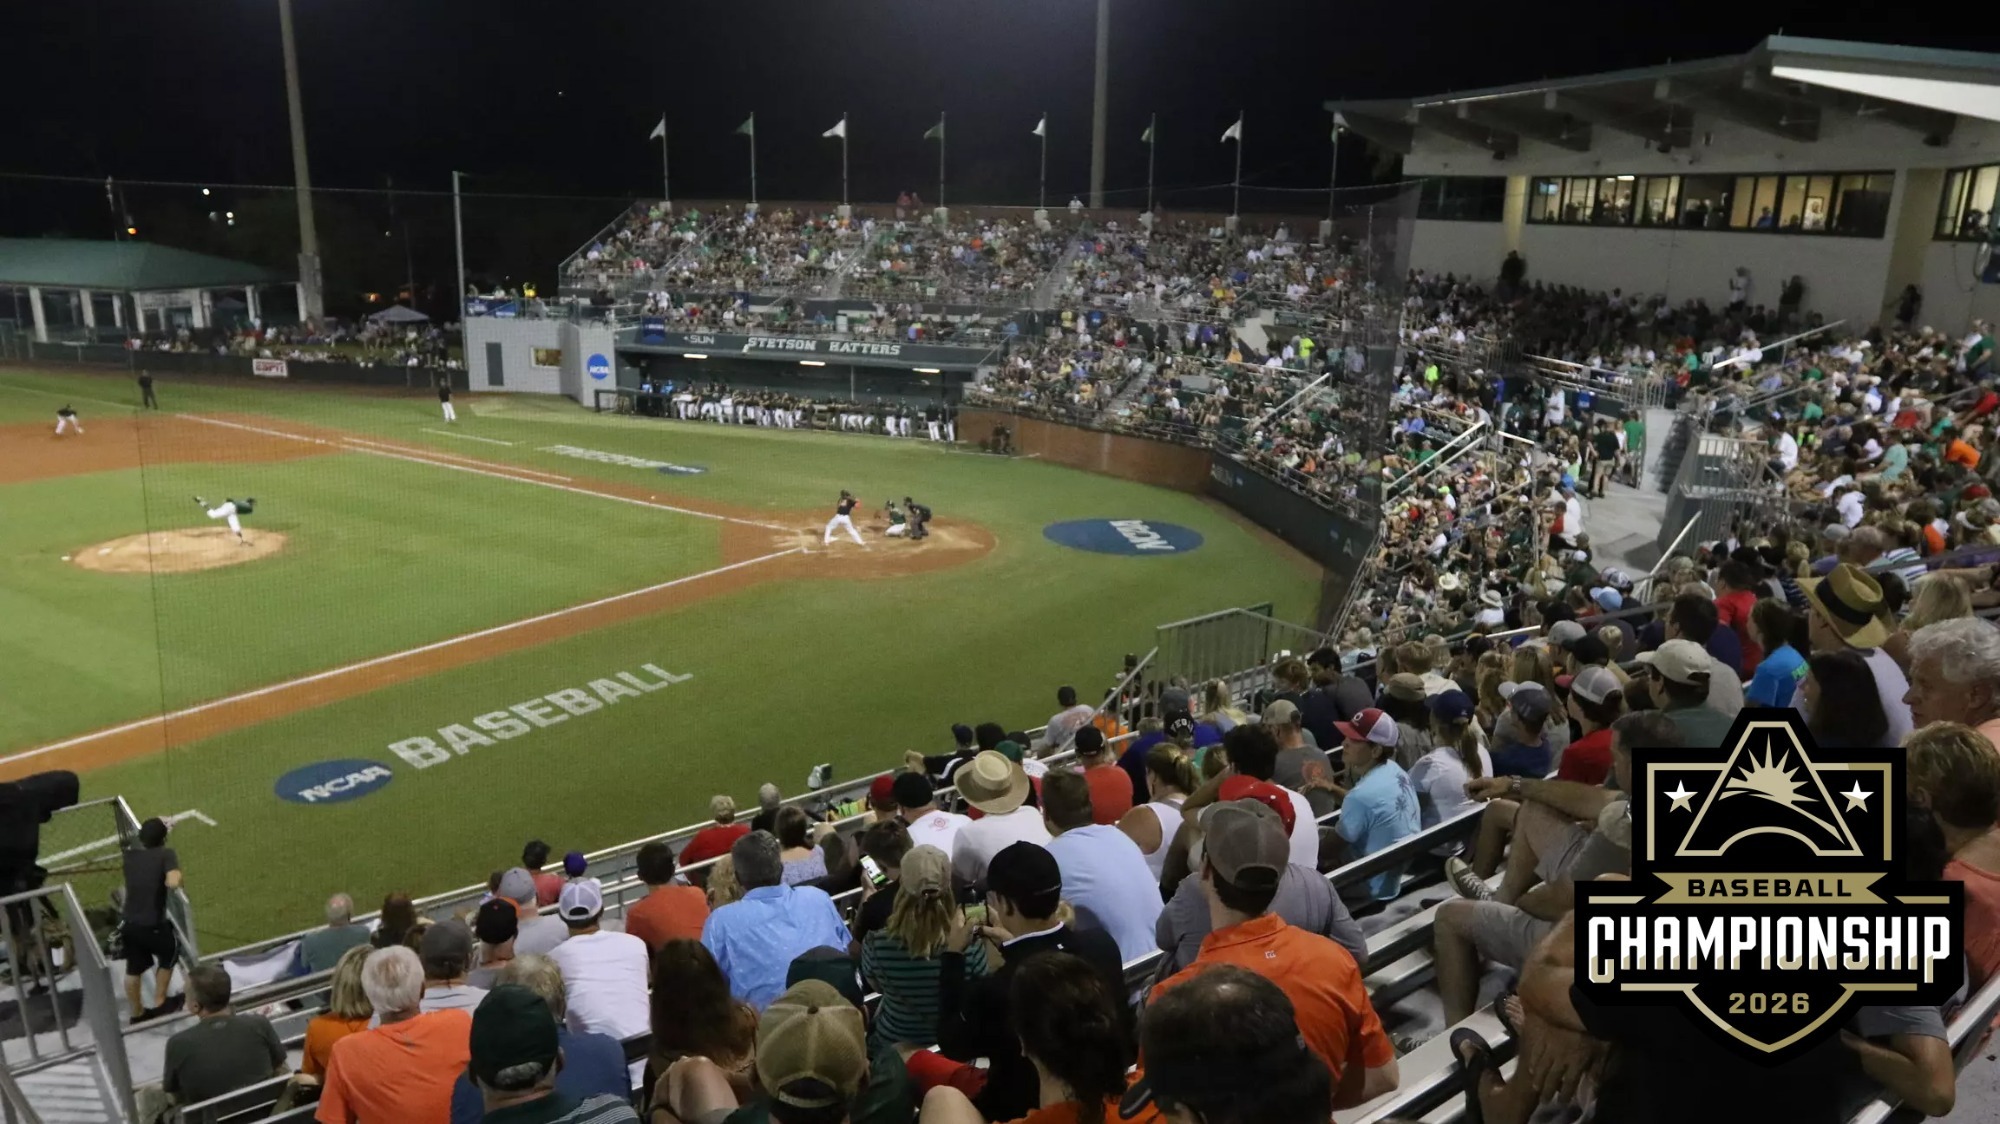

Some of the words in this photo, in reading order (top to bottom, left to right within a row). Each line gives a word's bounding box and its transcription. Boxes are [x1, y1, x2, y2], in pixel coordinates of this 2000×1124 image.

[747, 336, 817, 351] STETSON
[829, 341, 901, 356] HATTERS
[388, 662, 694, 769] BASEBALL
[298, 764, 392, 802] NCAA
